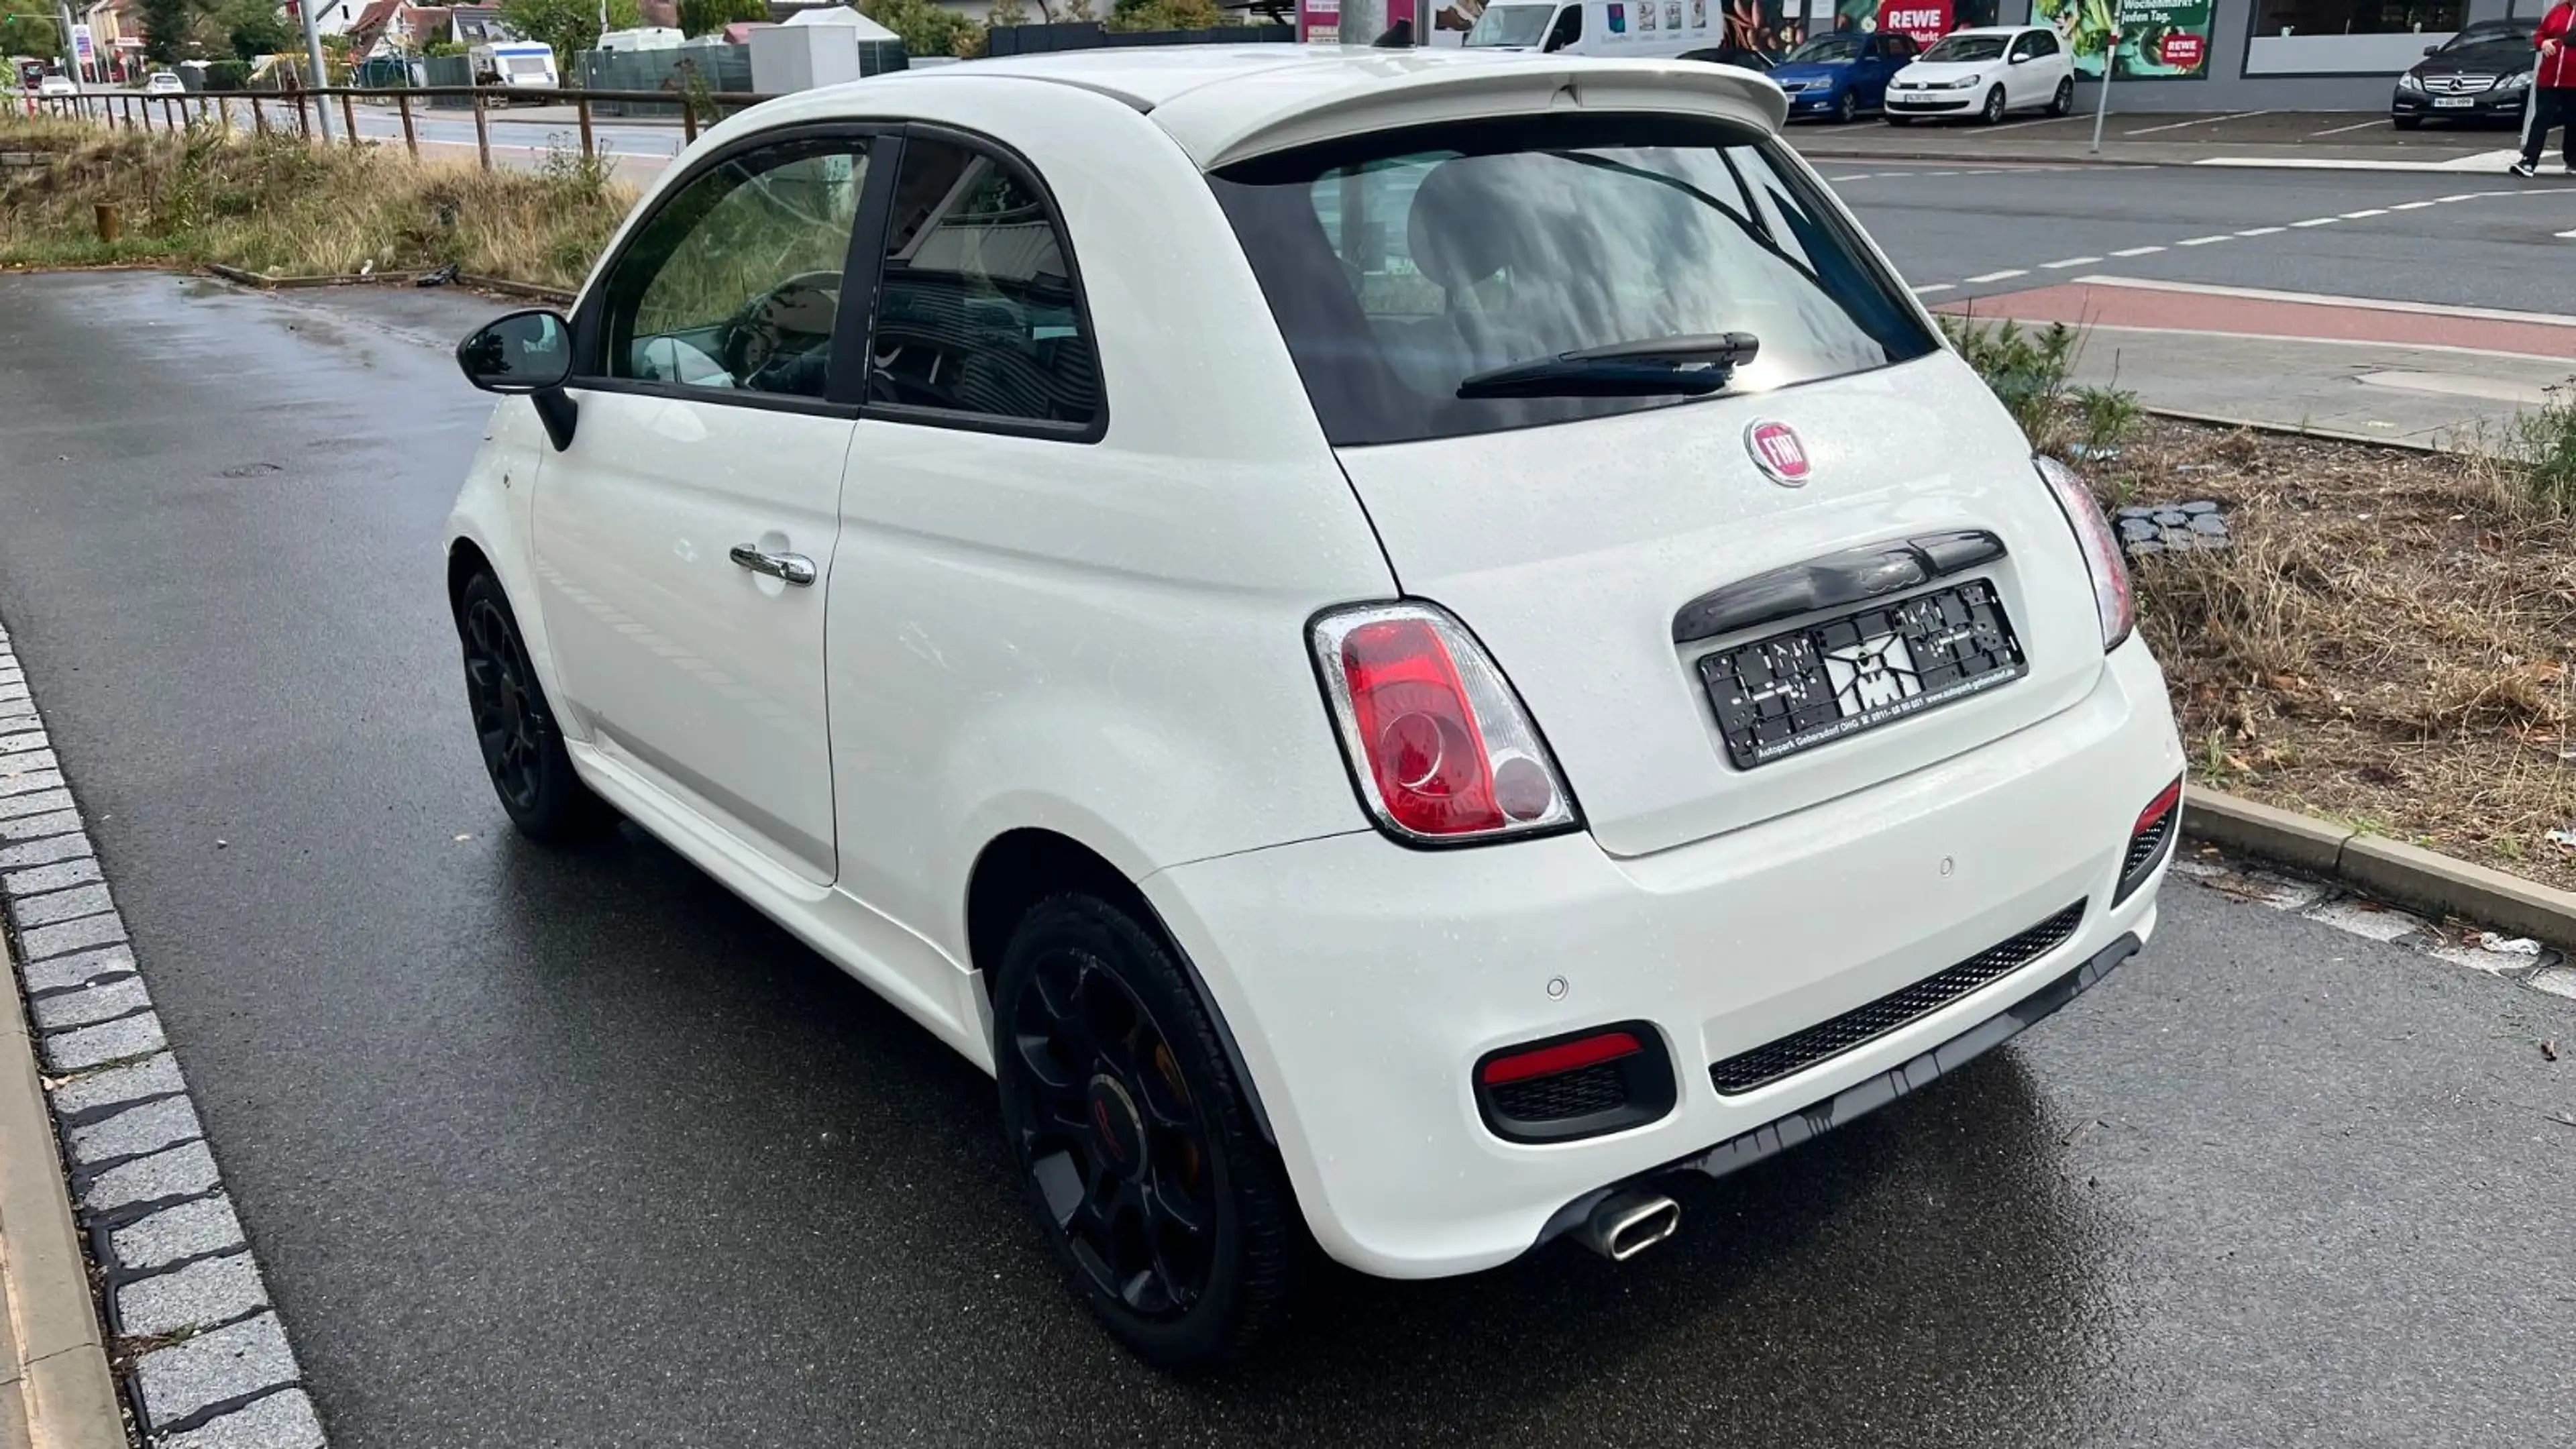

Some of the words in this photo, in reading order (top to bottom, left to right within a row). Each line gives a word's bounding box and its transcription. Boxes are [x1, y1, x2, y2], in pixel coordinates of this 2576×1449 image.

[1888, 9, 1941, 28] REWE
[2121, 11, 2149, 25] jeden
[1762, 435, 1803, 467] FIAT
[1758, 740, 1796, 759] Autopark
